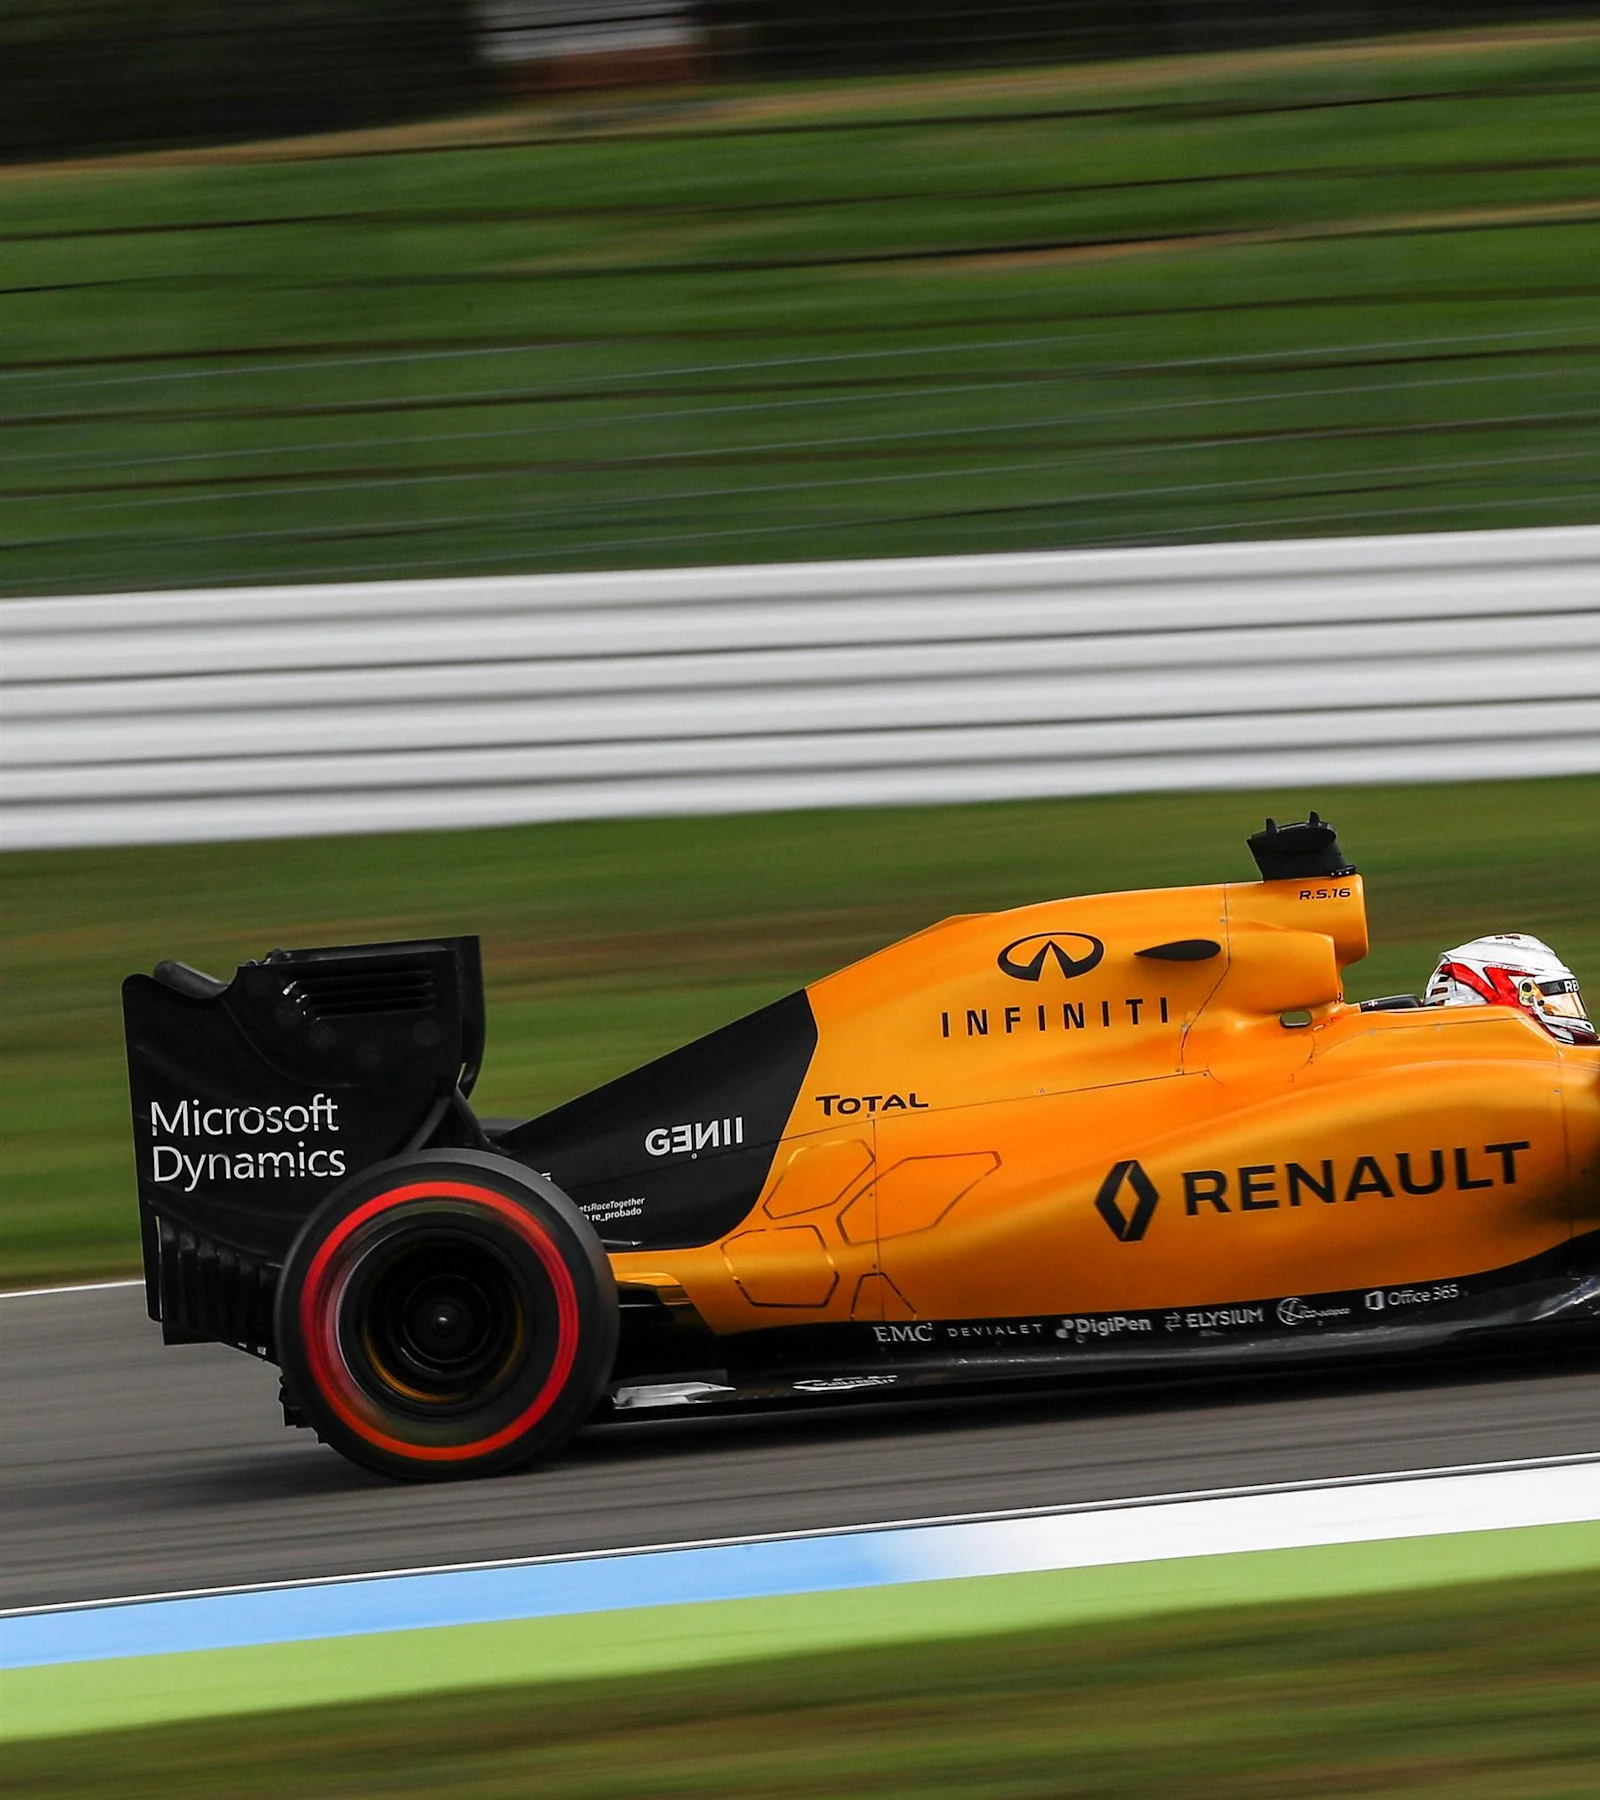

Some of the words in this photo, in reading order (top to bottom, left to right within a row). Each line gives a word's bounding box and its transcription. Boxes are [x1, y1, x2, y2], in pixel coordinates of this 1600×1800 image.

[1299, 888, 1351, 901] R.S.16
[941, 997, 1169, 1038] INFINITI
[151, 1093, 340, 1137] Microsoft
[153, 1141, 346, 1192] Dynamics
[1181, 1140, 1530, 1216] RENAULT
[1388, 1289, 1431, 1306] Office
[1432, 1284, 1459, 1300] 365
[1075, 1316, 1153, 1337] DigiPen
[1186, 1308, 1264, 1329] ELYSIUM
[947, 1323, 1043, 1338] DEVIALET
